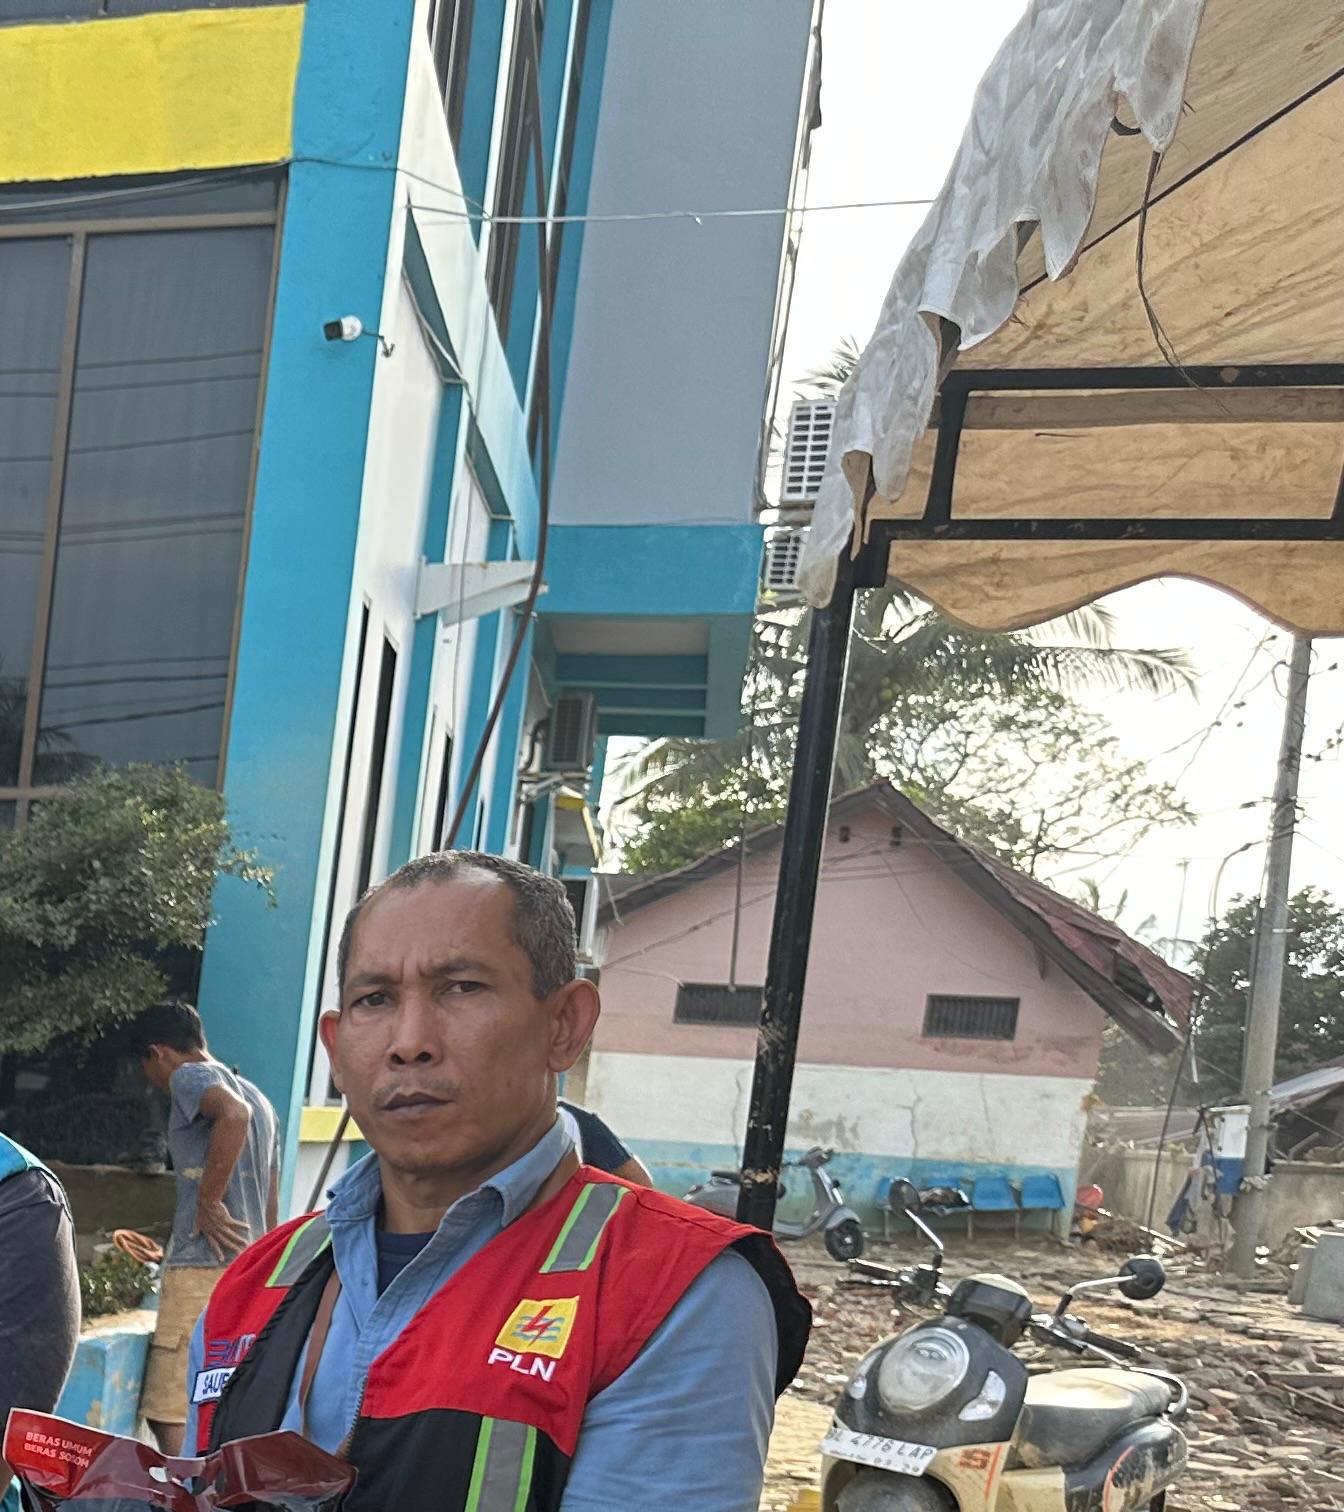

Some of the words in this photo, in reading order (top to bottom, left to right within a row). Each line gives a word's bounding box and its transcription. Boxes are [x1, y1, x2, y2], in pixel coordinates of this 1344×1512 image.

[488, 1348, 556, 1382] PLN
[25, 1432, 61, 1447] BERAS
[24, 1443, 56, 1458] BERAS
